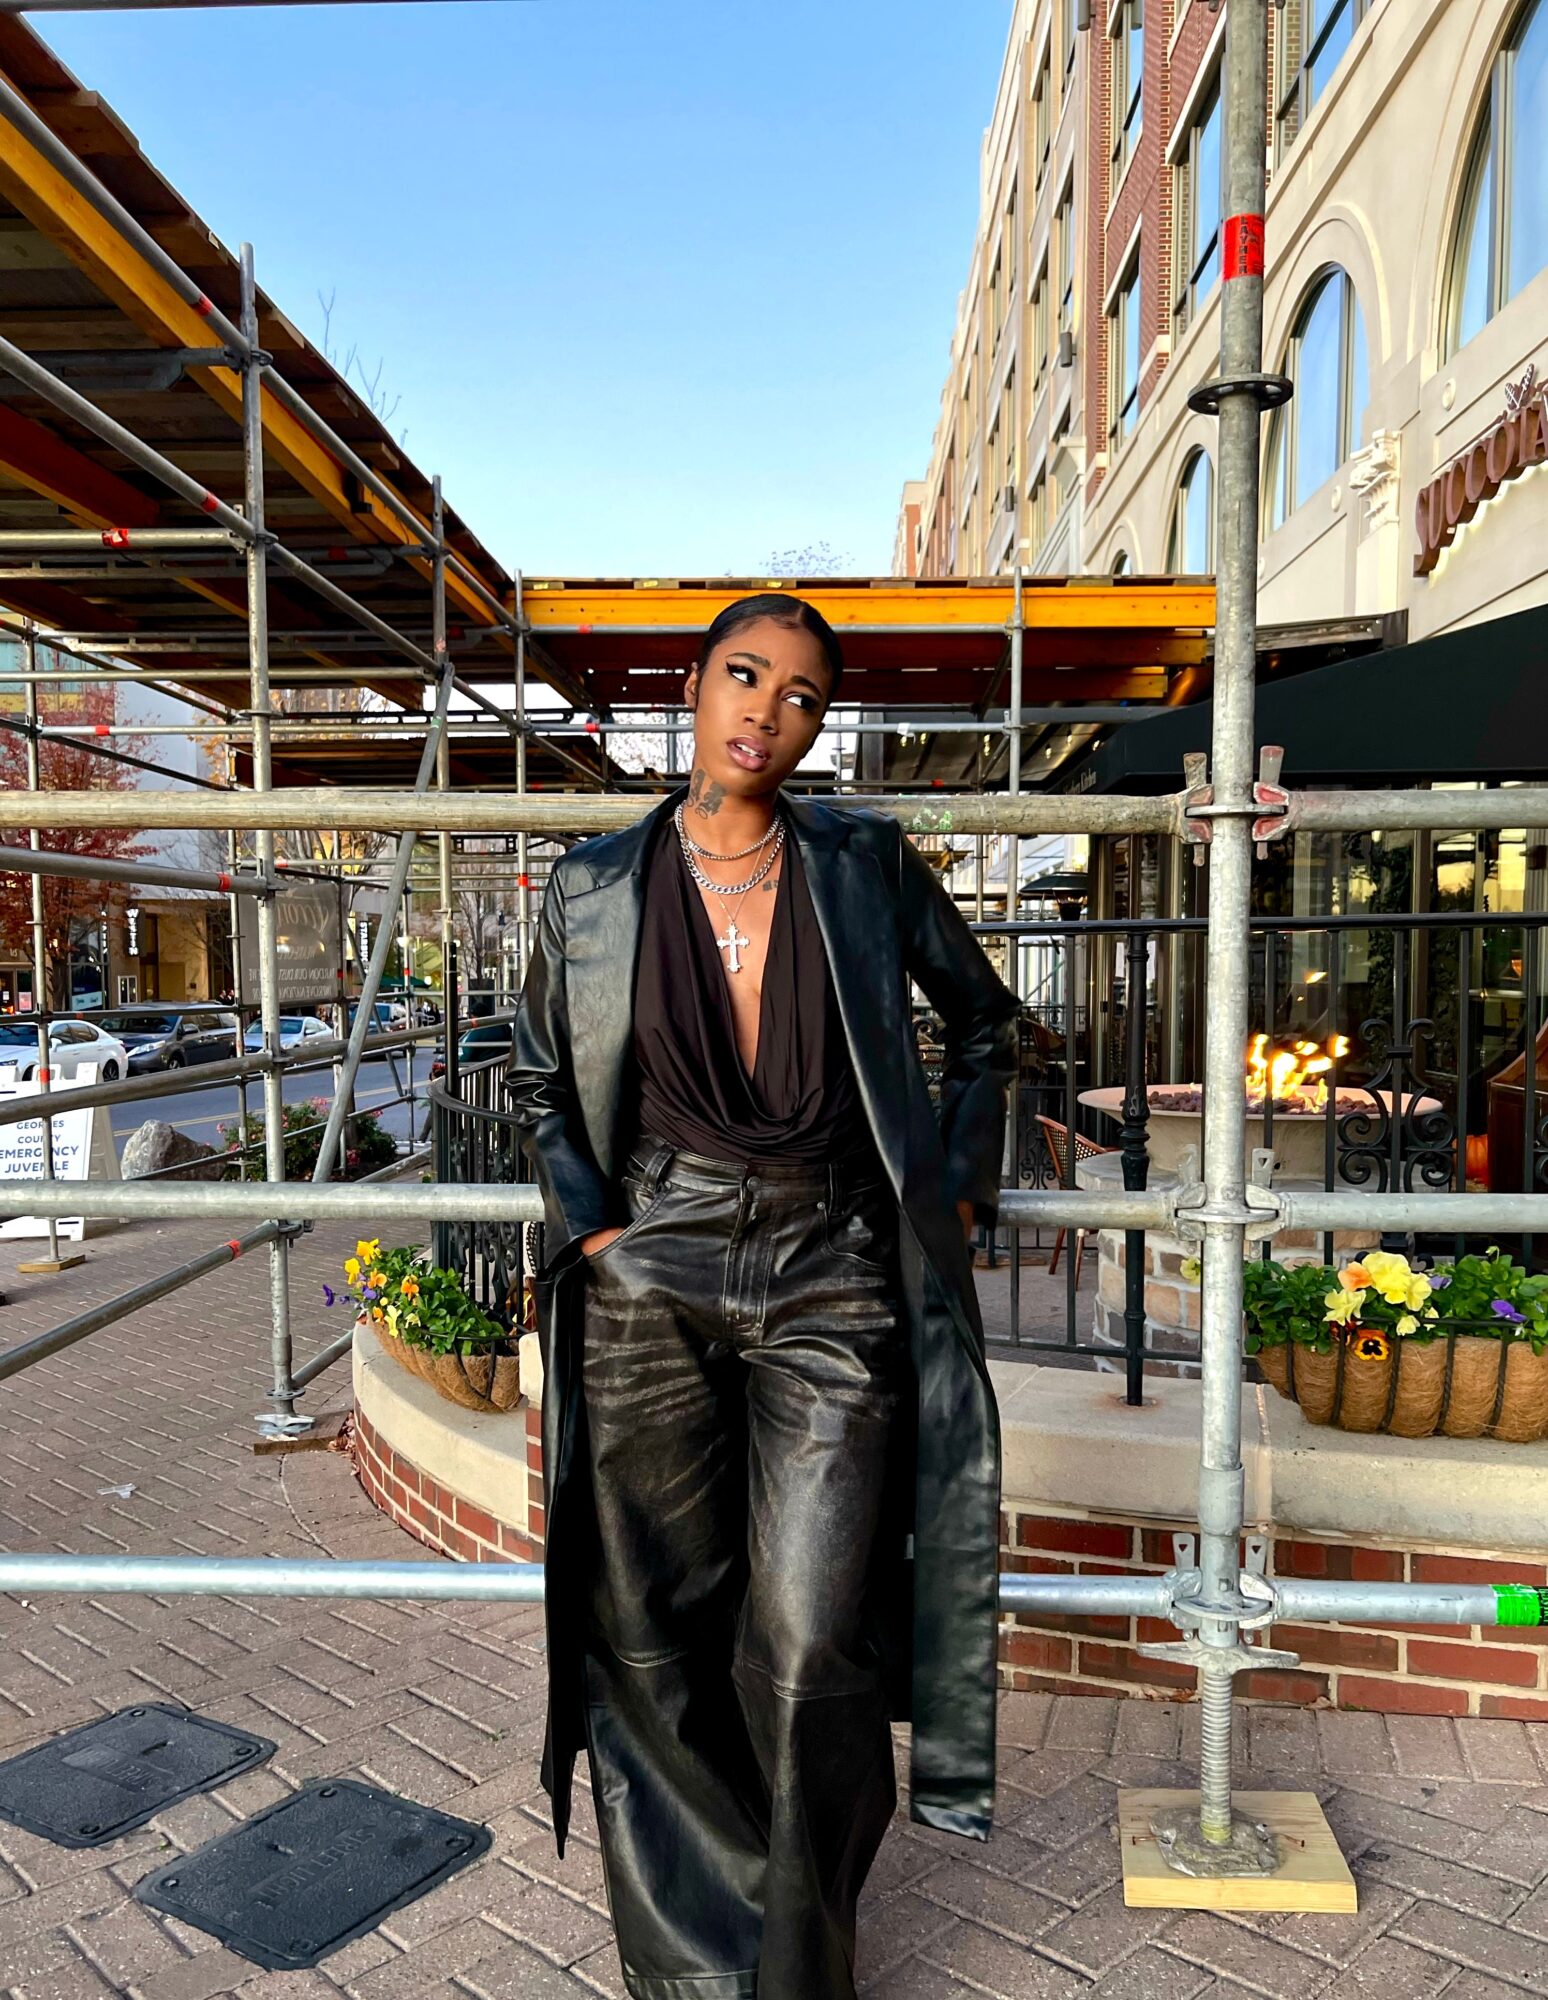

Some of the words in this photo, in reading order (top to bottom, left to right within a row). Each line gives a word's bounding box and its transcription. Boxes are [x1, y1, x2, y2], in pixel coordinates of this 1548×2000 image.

[1239, 215, 1249, 275] LAYHER
[360, 921, 368, 974] STARBUC
[16, 1120, 64, 1130] GEORES
[17, 1134, 61, 1144] COUY
[0, 1145, 79, 1160] EMERGNCY
